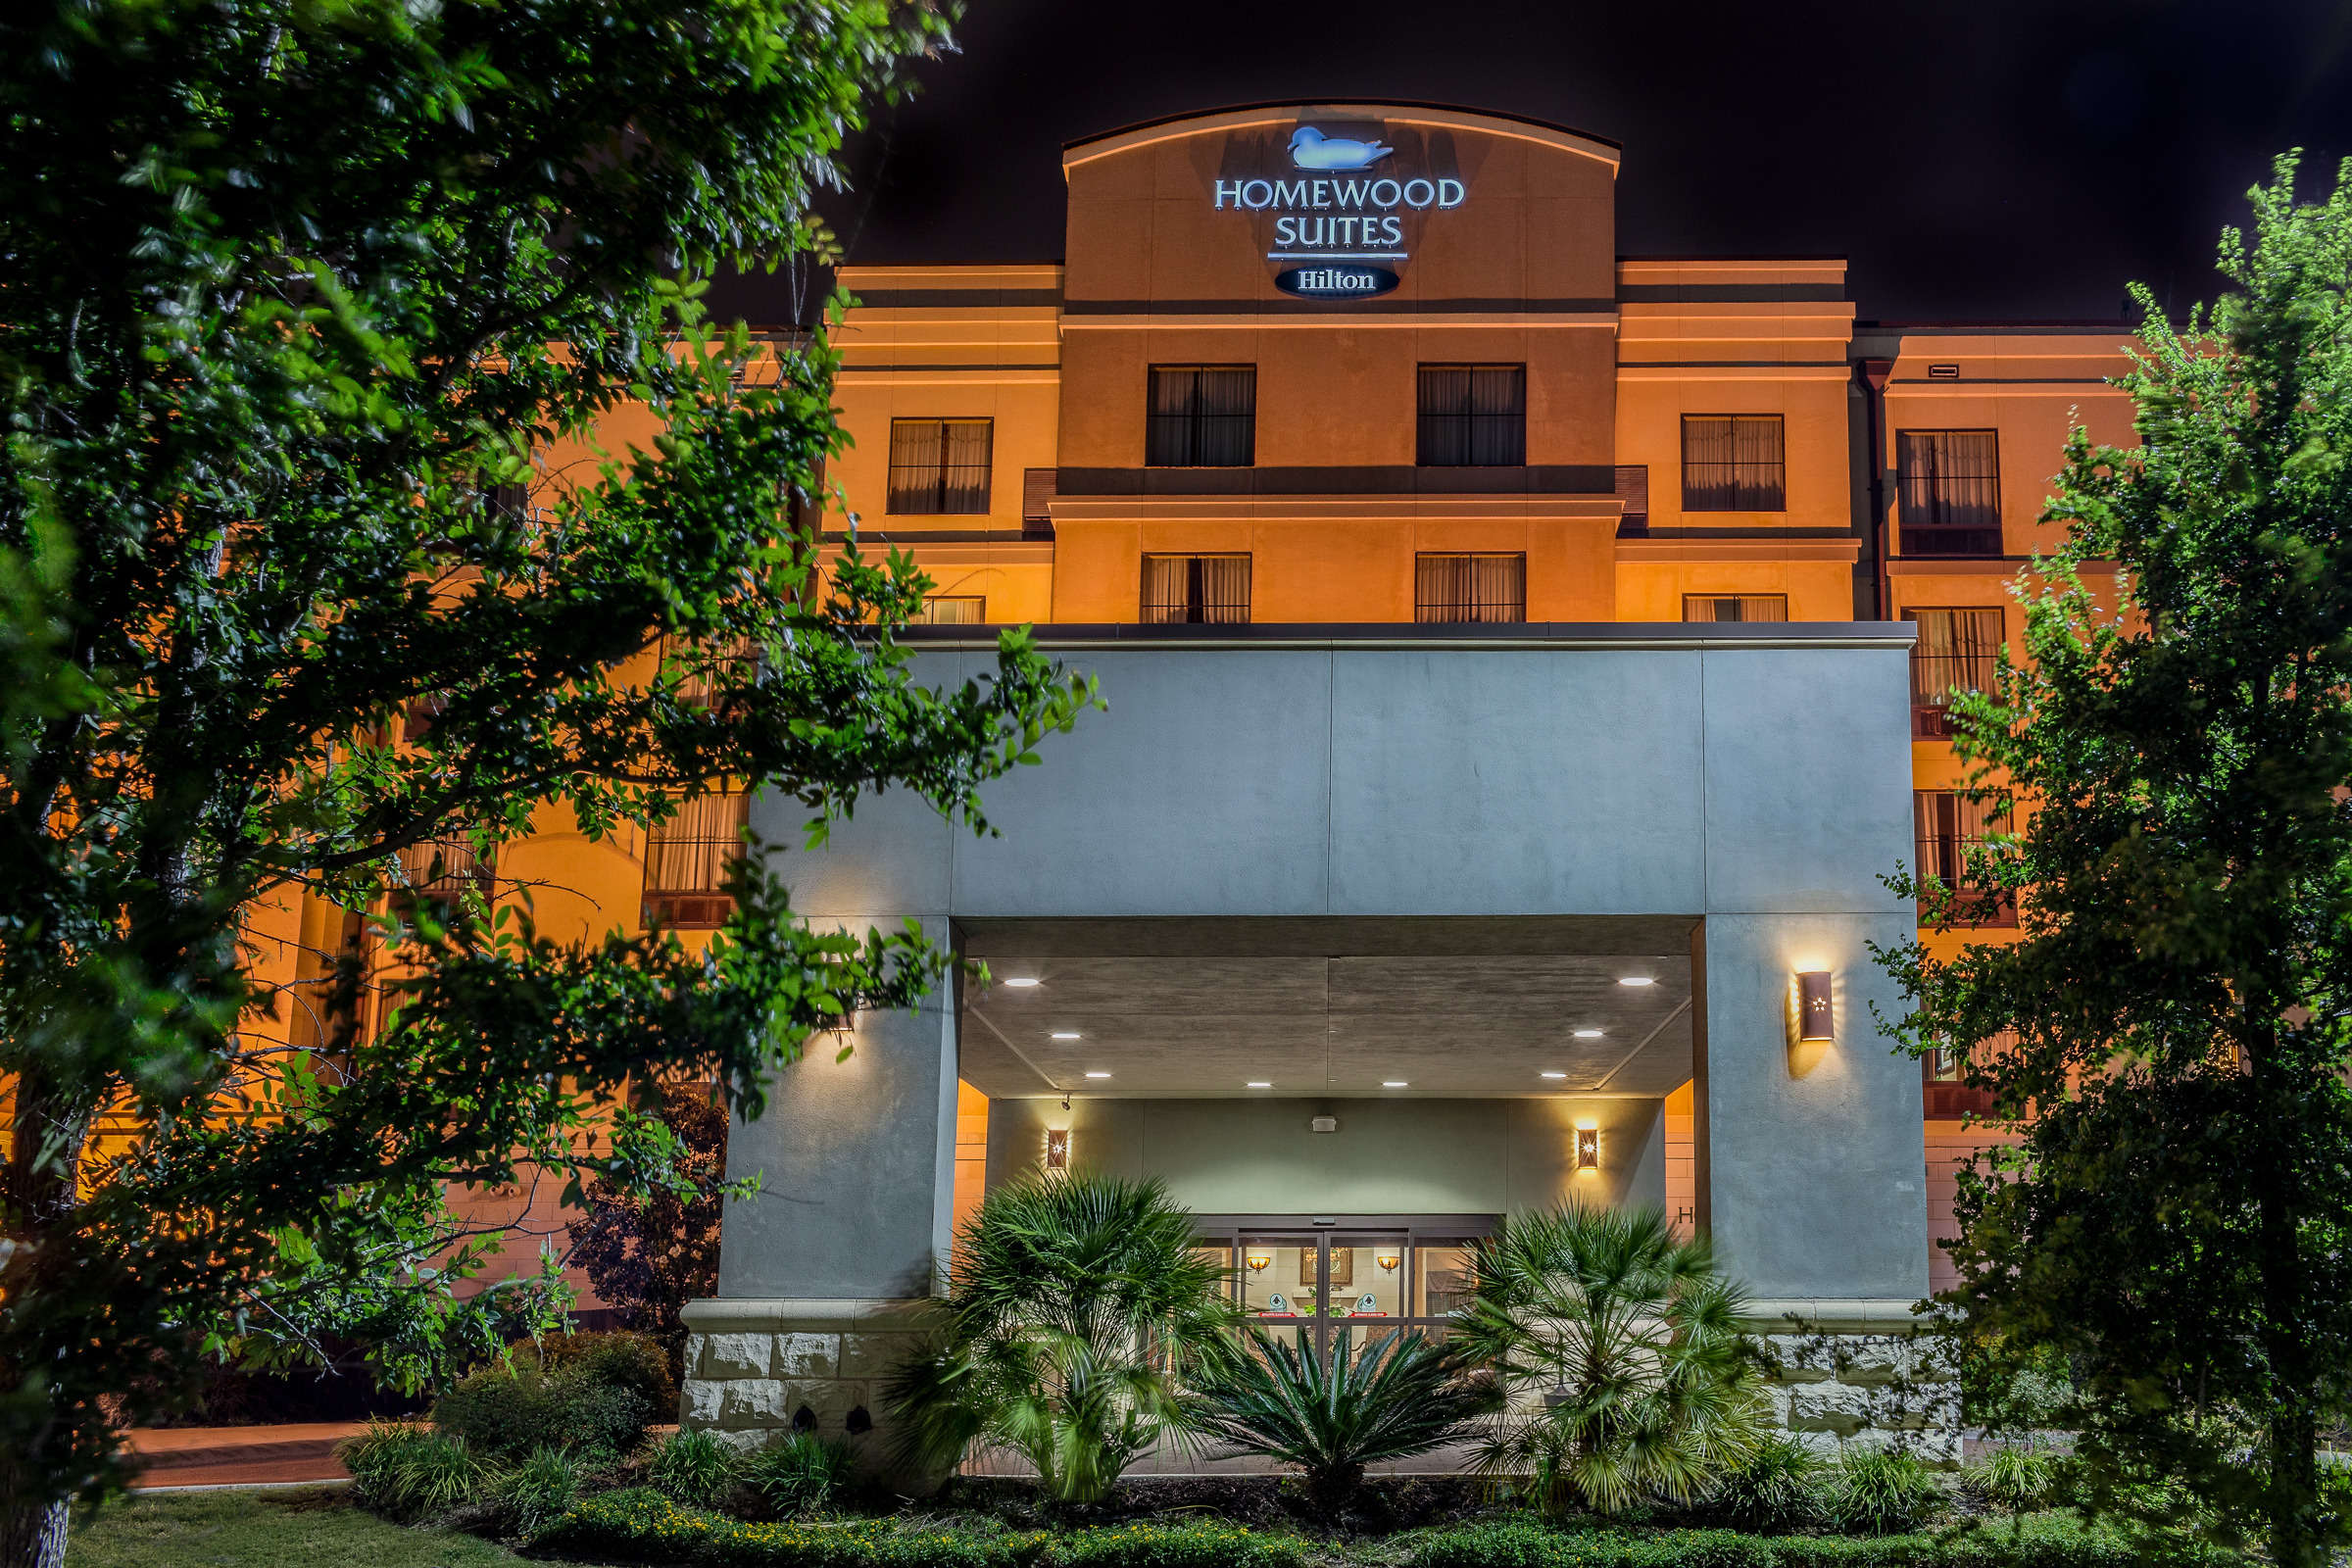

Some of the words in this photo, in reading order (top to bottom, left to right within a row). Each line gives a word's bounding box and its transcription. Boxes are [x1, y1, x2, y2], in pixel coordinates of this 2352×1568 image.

[1214, 178, 1465, 209] HOMEWOOD
[1275, 216, 1402, 246] SUITES
[1298, 269, 1377, 291] Hilton
